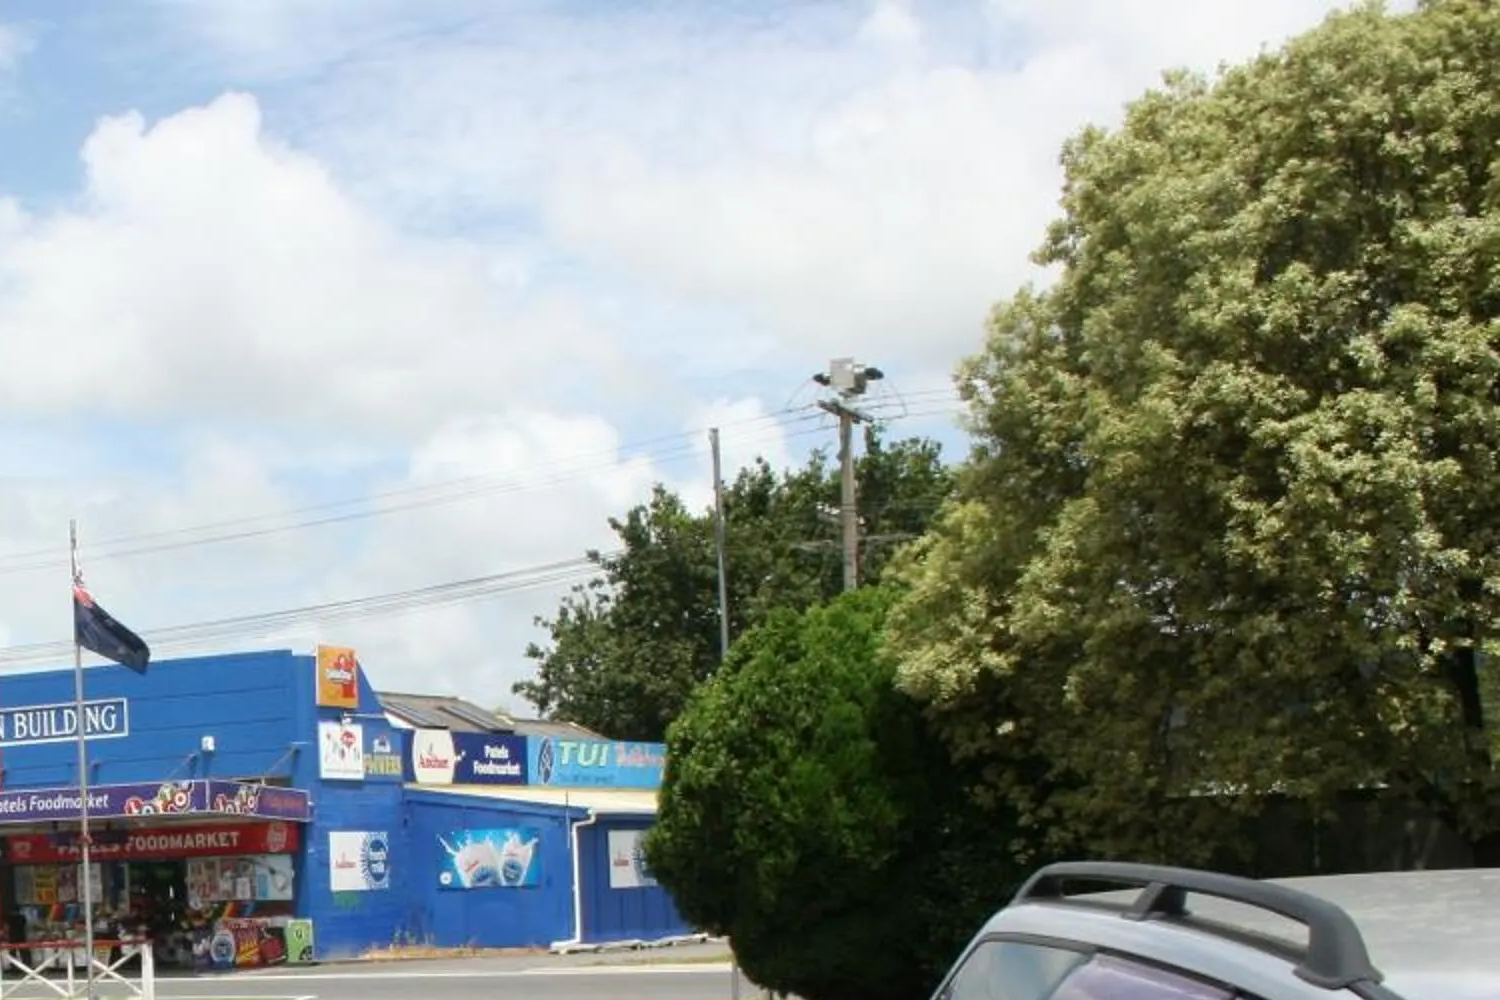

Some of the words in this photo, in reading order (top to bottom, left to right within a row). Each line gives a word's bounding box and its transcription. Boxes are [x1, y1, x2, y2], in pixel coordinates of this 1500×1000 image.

[14, 704, 117, 739] BUILDNG
[558, 741, 608, 767] TUI
[29, 793, 109, 811] Foodmaket
